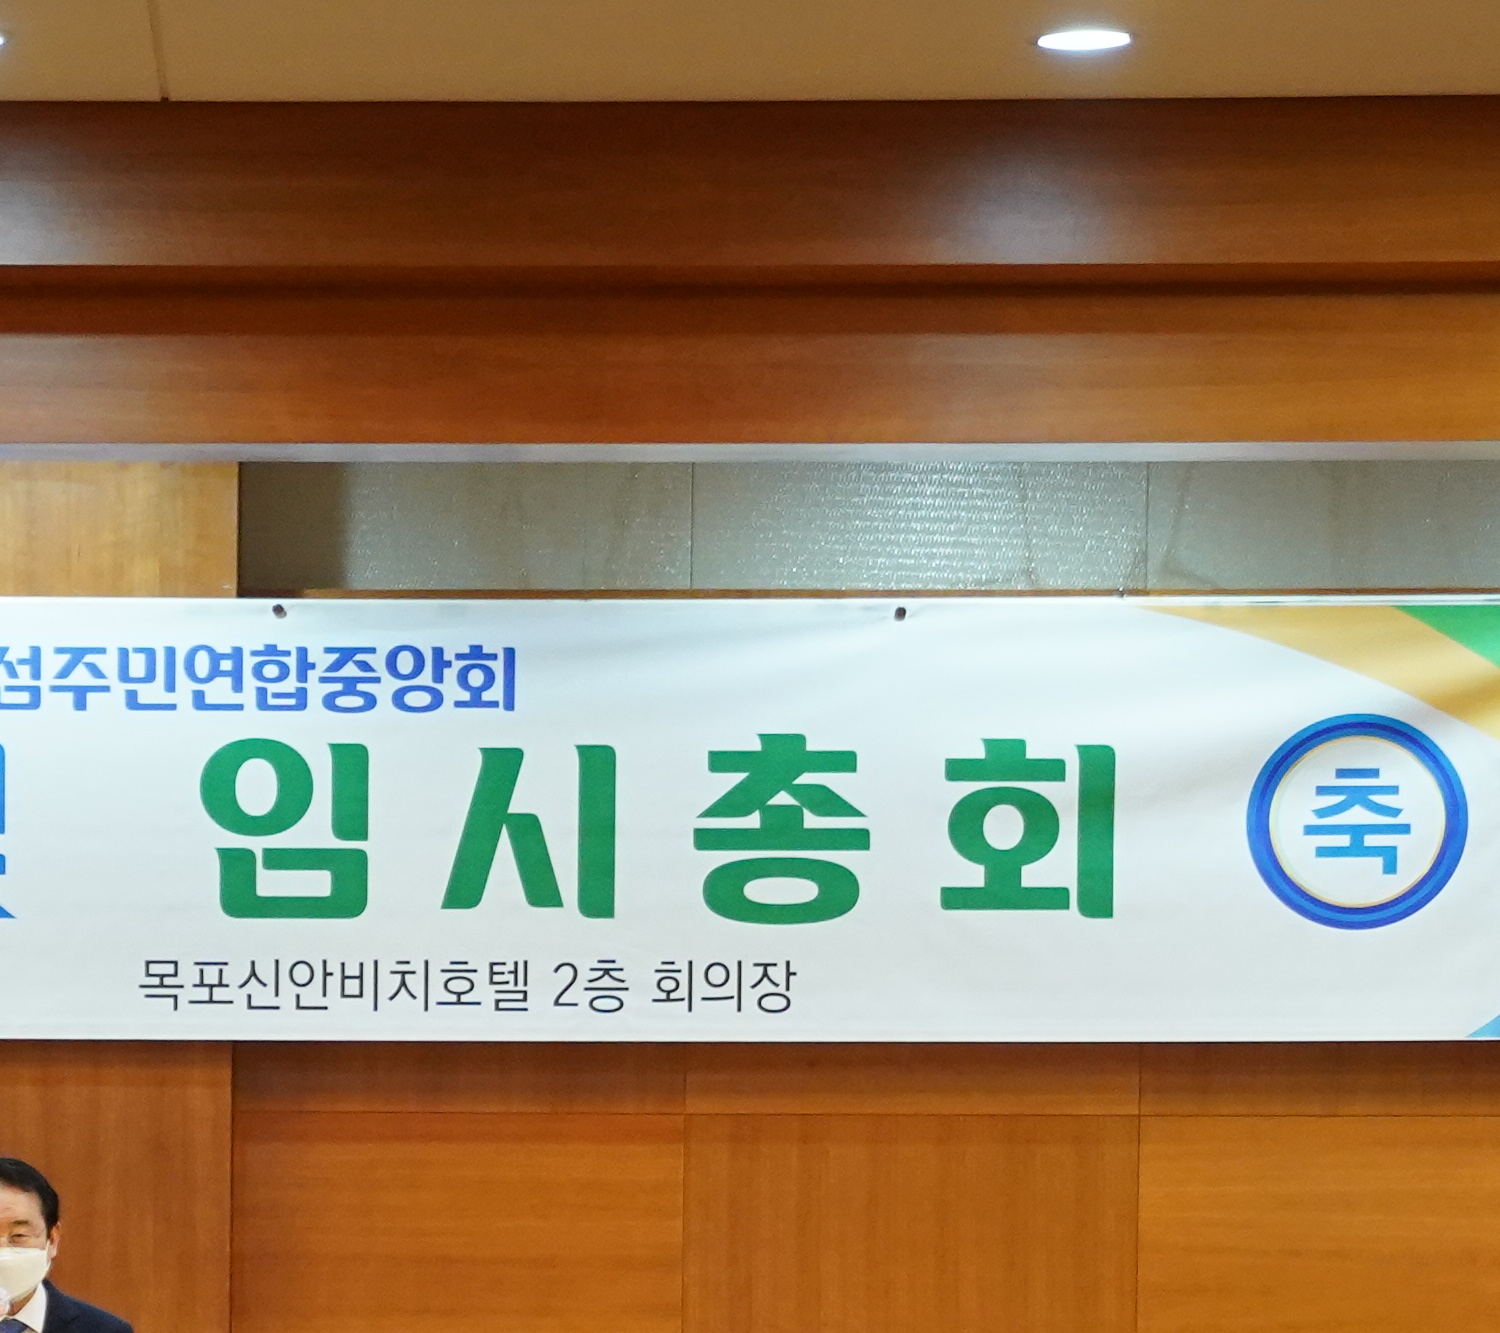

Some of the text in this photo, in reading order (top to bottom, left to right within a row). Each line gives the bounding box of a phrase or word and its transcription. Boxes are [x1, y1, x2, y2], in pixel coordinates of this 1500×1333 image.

[200, 733, 1116, 925] 임시총회
[1303, 766, 1414, 876] 축
[139, 959, 797, 1013] 목포신안비치호텔 2층 회의장
